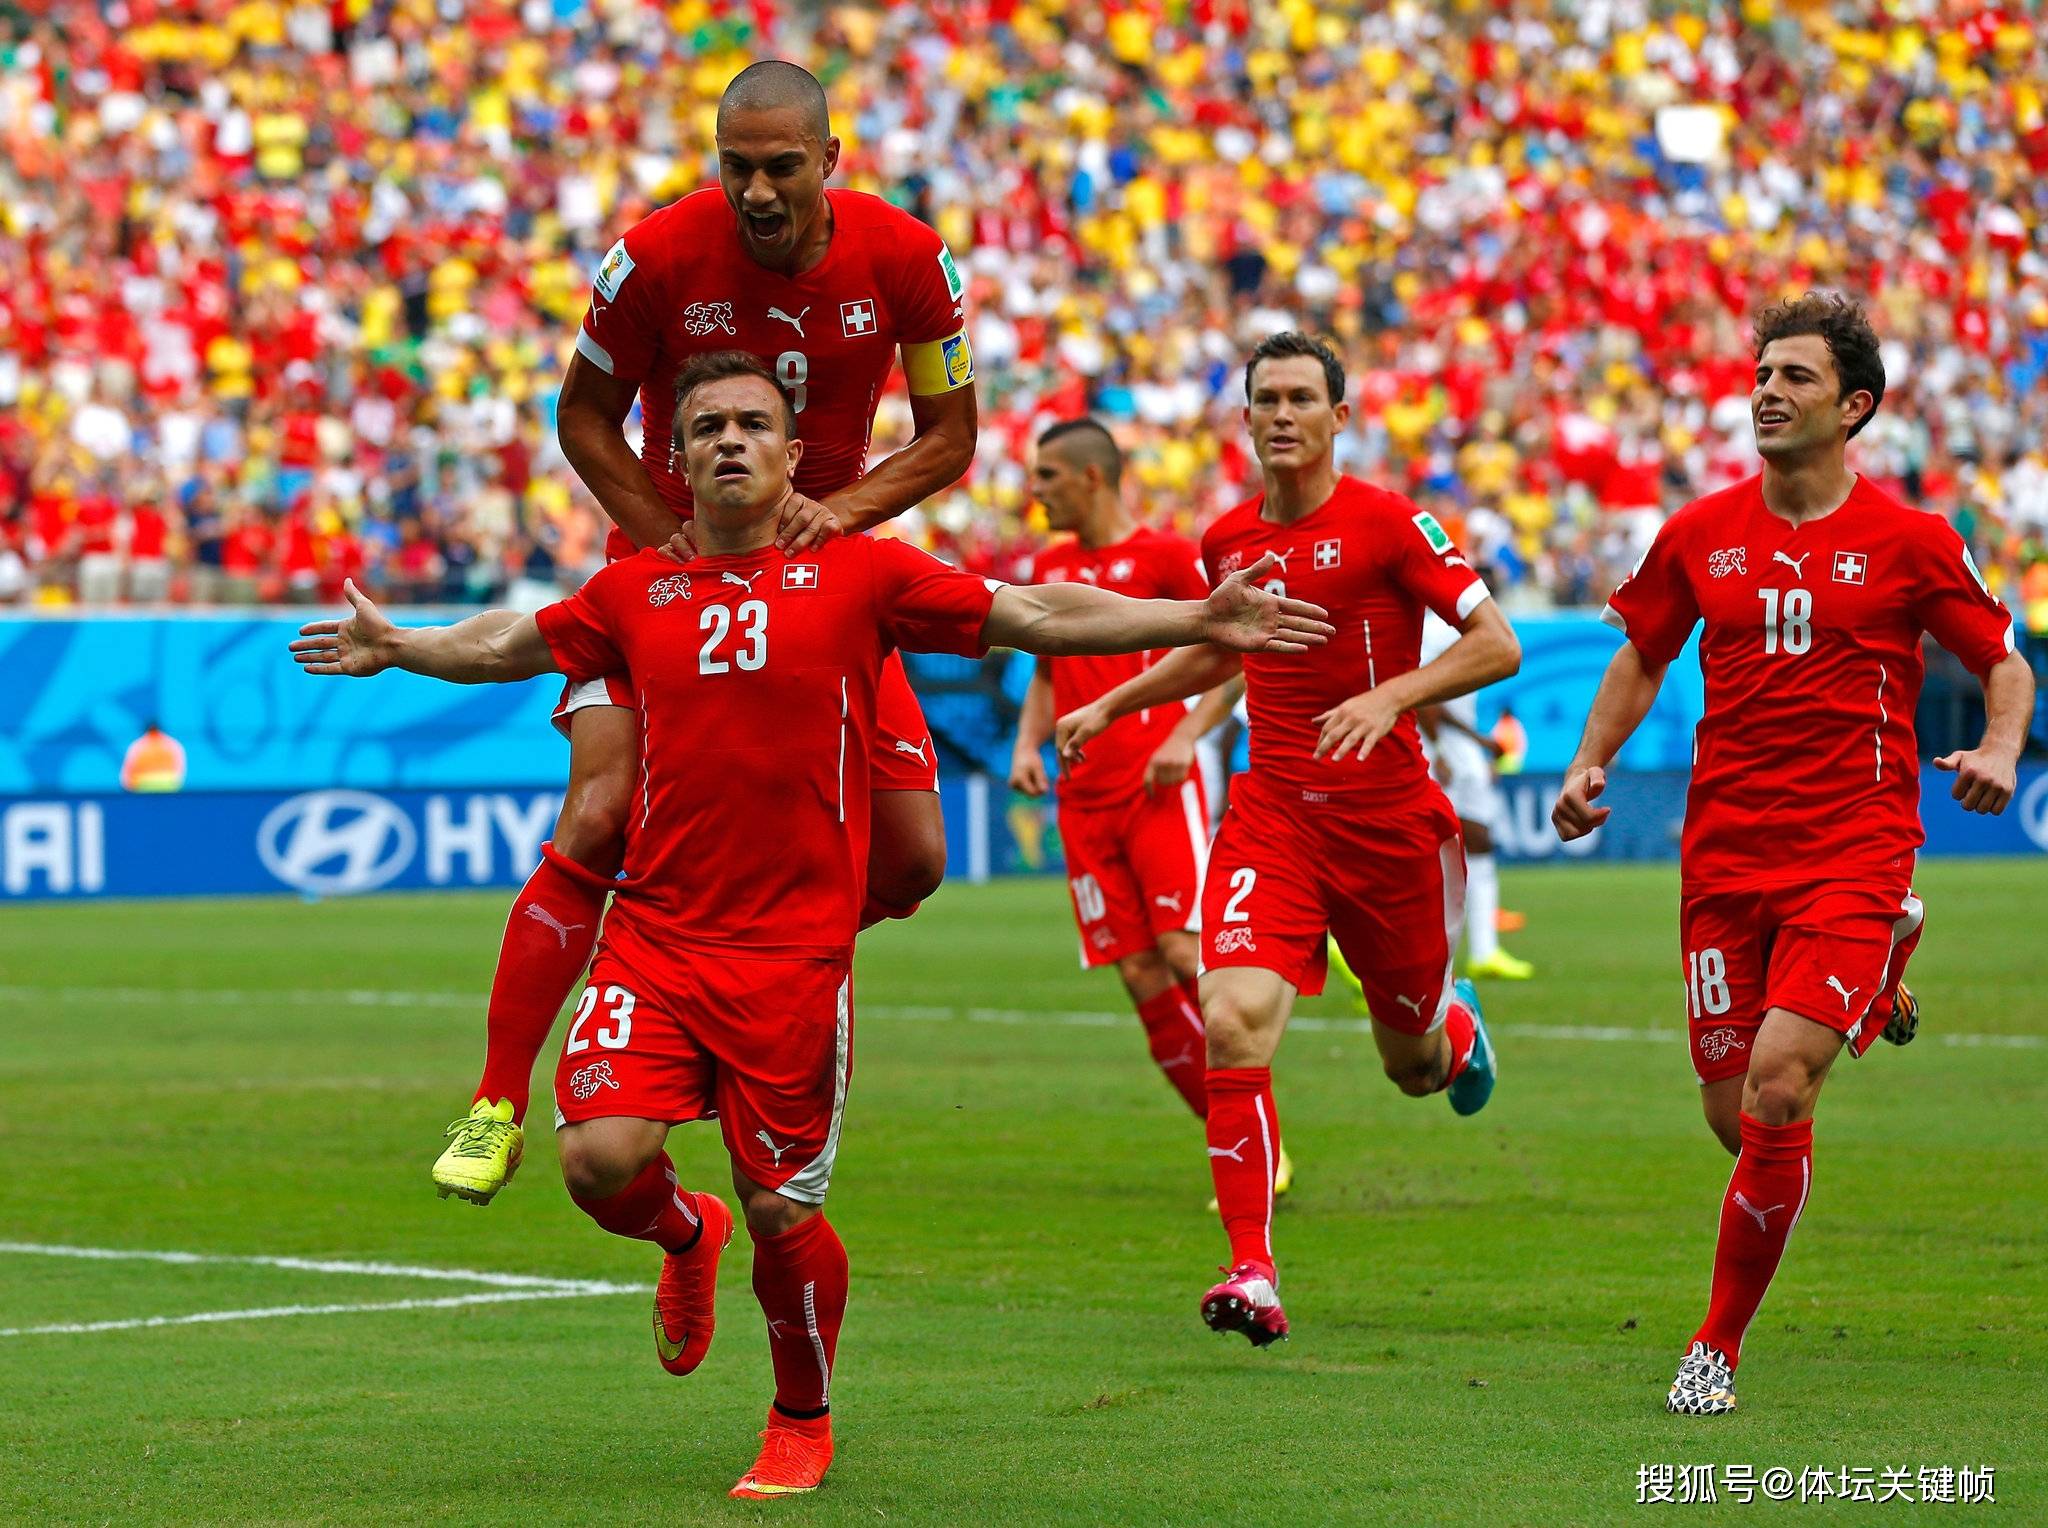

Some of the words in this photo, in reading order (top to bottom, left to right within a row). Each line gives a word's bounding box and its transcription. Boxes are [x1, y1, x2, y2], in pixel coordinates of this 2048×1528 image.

[776, 351, 808, 414] 8
[699, 600, 768, 675] 23
[1758, 588, 1813, 655] 18
[426, 794, 566, 884] HY
[1072, 873, 1106, 925] 10
[1223, 867, 1257, 923] 2
[1689, 948, 1732, 1019] 18
[566, 985, 636, 1056] 23
